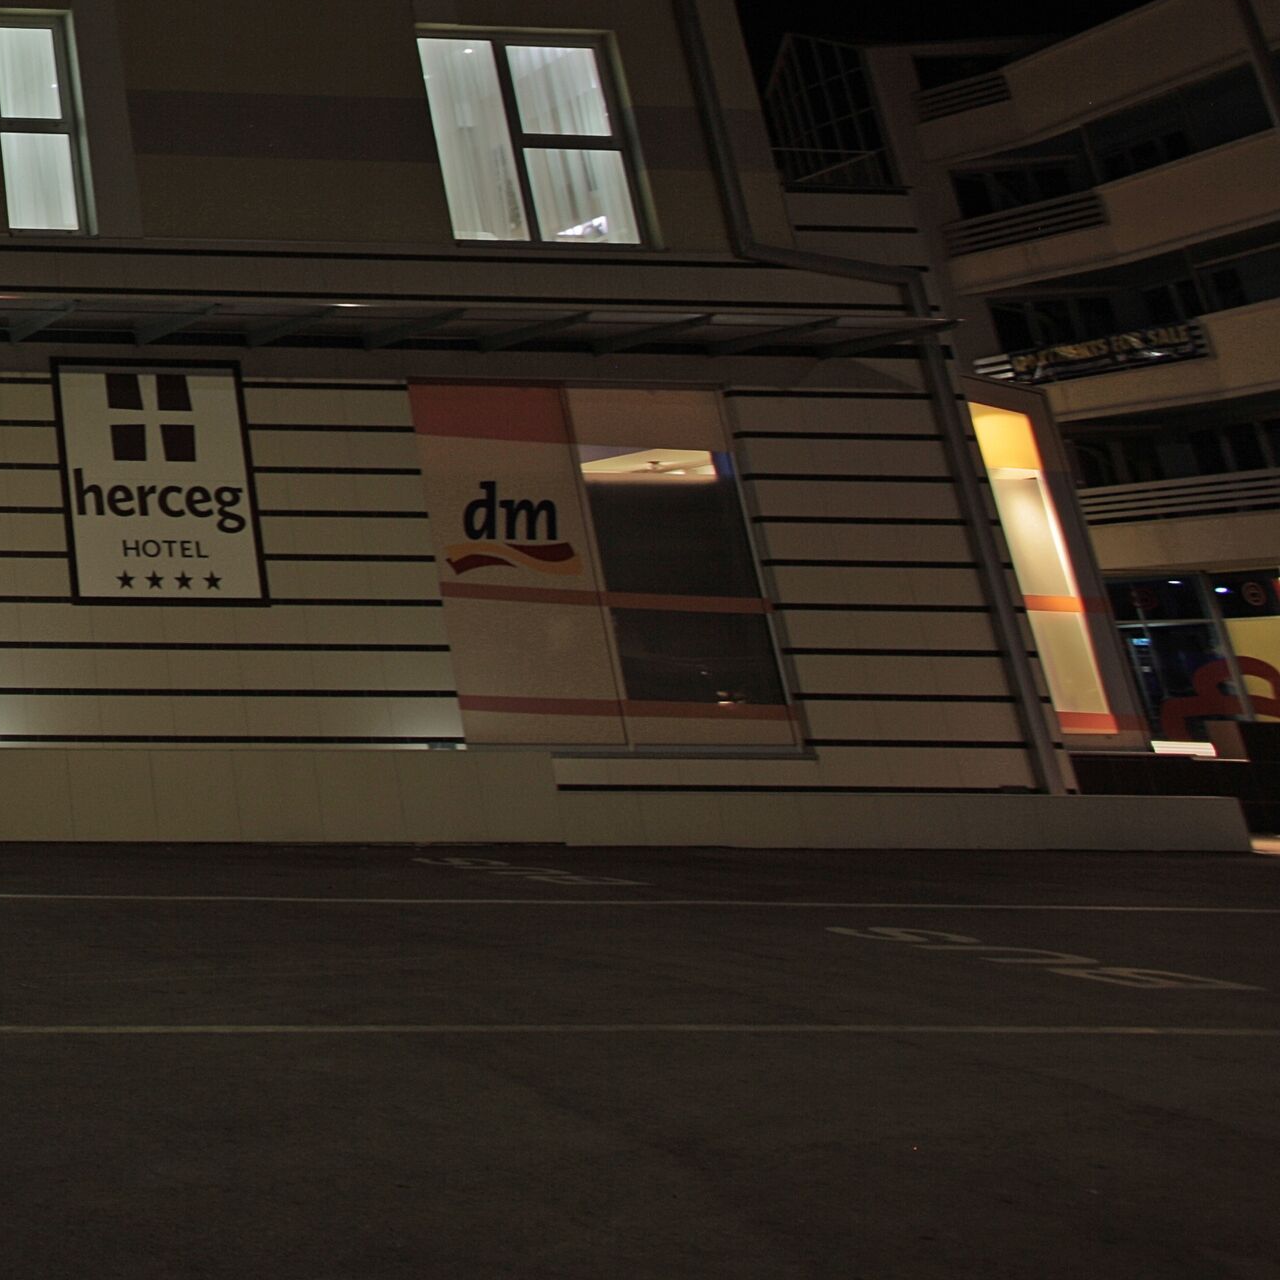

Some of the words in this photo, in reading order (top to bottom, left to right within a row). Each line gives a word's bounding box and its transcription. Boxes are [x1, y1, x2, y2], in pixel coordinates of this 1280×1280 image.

[72, 467, 246, 534] herceg
[462, 480, 559, 541] dm
[122, 539, 209, 559] HOTEL
